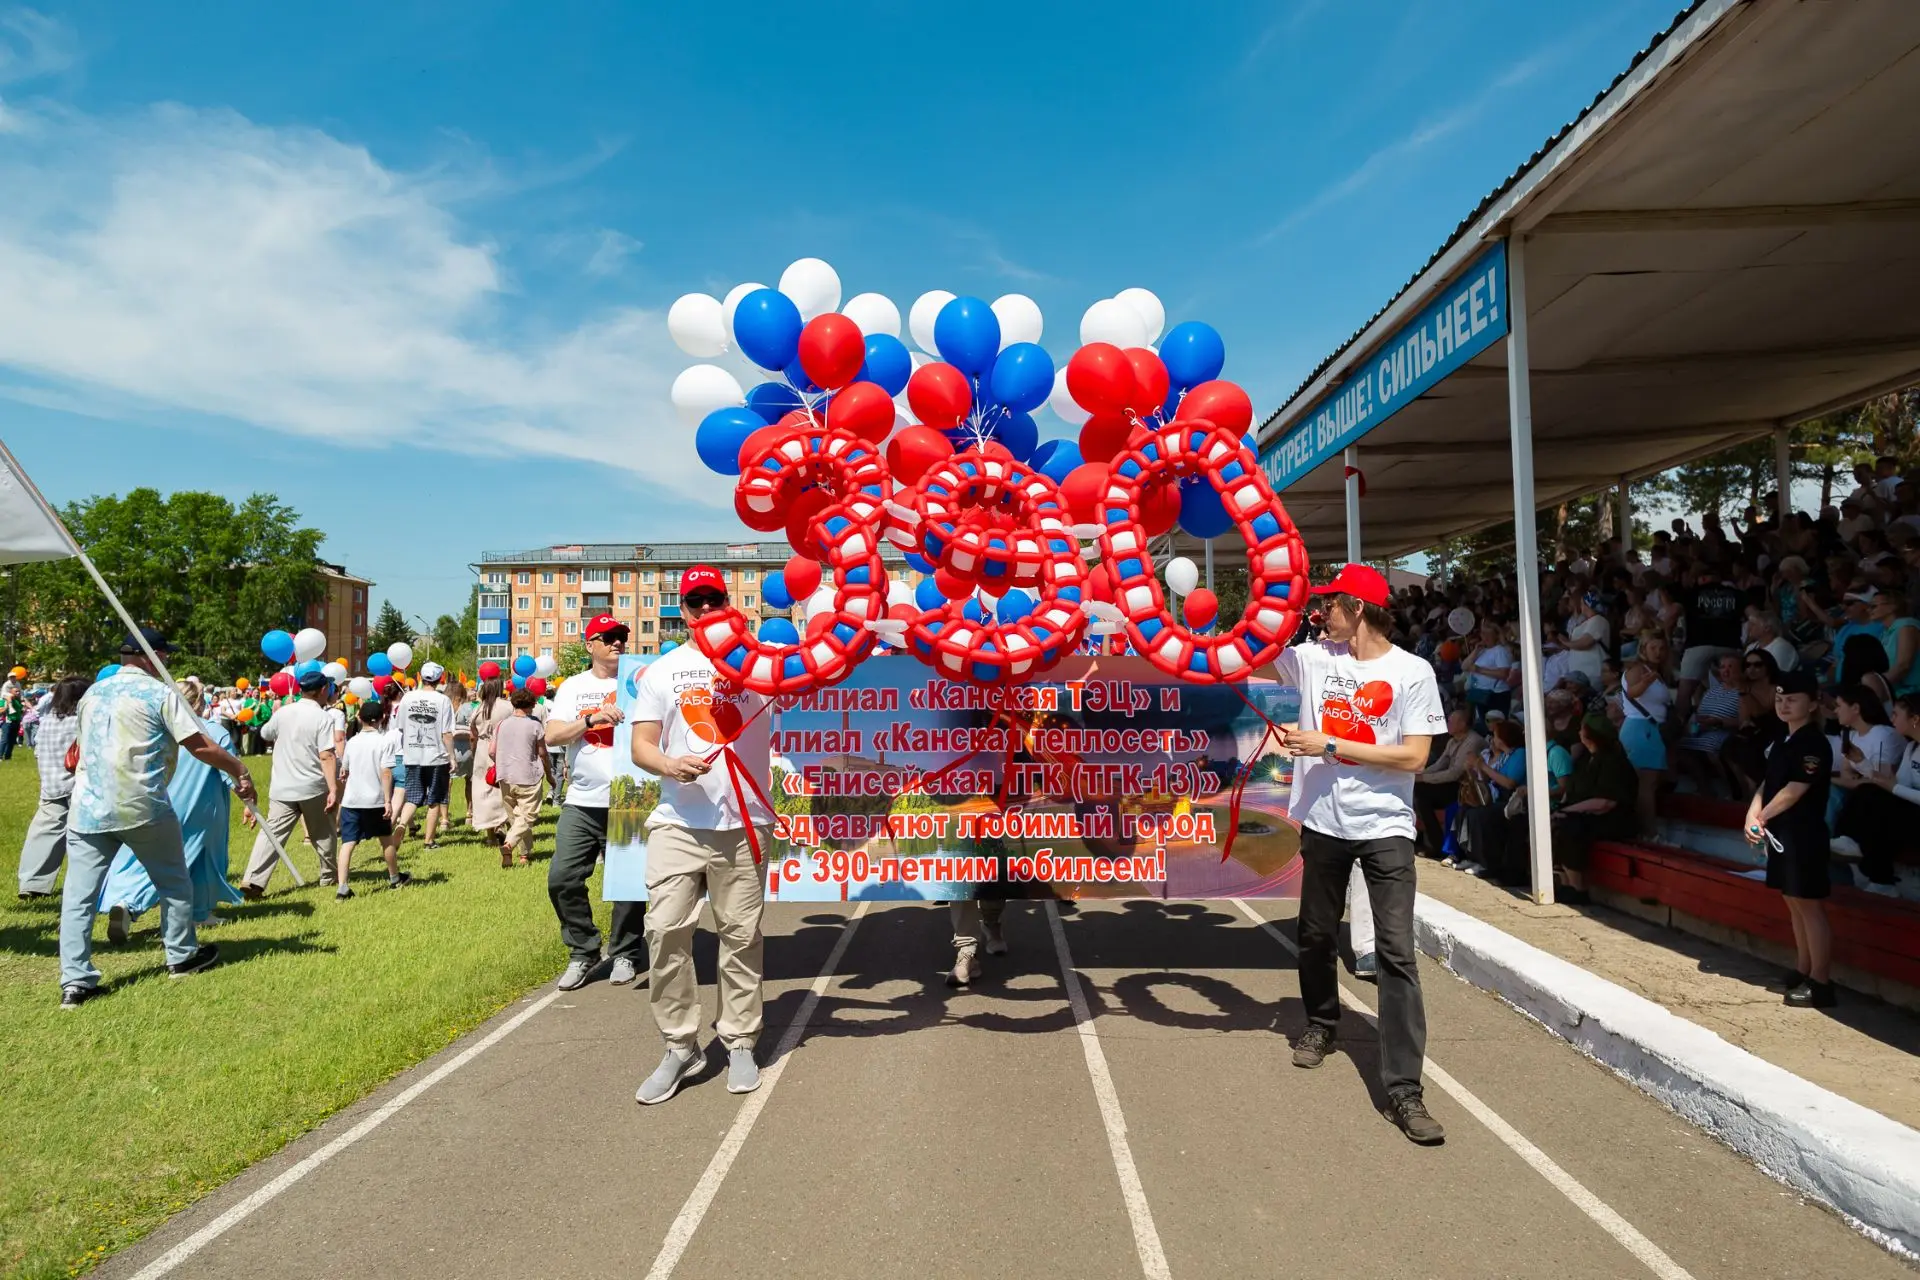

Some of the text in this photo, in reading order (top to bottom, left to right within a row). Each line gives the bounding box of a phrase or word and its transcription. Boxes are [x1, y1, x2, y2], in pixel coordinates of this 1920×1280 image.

[1260, 266, 1499, 486] ЫСТРЕЕ! ВЫШЕ! СИЛЬНЕЕ!
[672, 669, 718, 681] ГРЕЕМ
[1324, 675, 1365, 690] ГРЕЕМ
[673, 680, 731, 694] СВЕТИМ
[908, 679, 1058, 712] «Канская
[1065, 680, 1151, 717] ТЭЦ»
[1160, 687, 1181, 712] и
[674, 694, 749, 708] РАБОТАЕМ
[1321, 689, 1374, 709] СВЕТИМ
[1317, 705, 1389, 728] РАБОТАЕМ
[1434, 714, 1446, 722] СГ
[770, 721, 1211, 754] илиал «Канская теплосеть»
[782, 763, 995, 796] «Енисейская
[1002, 762, 1064, 796] ТГК
[1071, 762, 1221, 803] (ТГК-13)»
[773, 804, 1217, 846] здравляют любимый город
[782, 847, 1167, 883] с 390-летним юбилеем!
